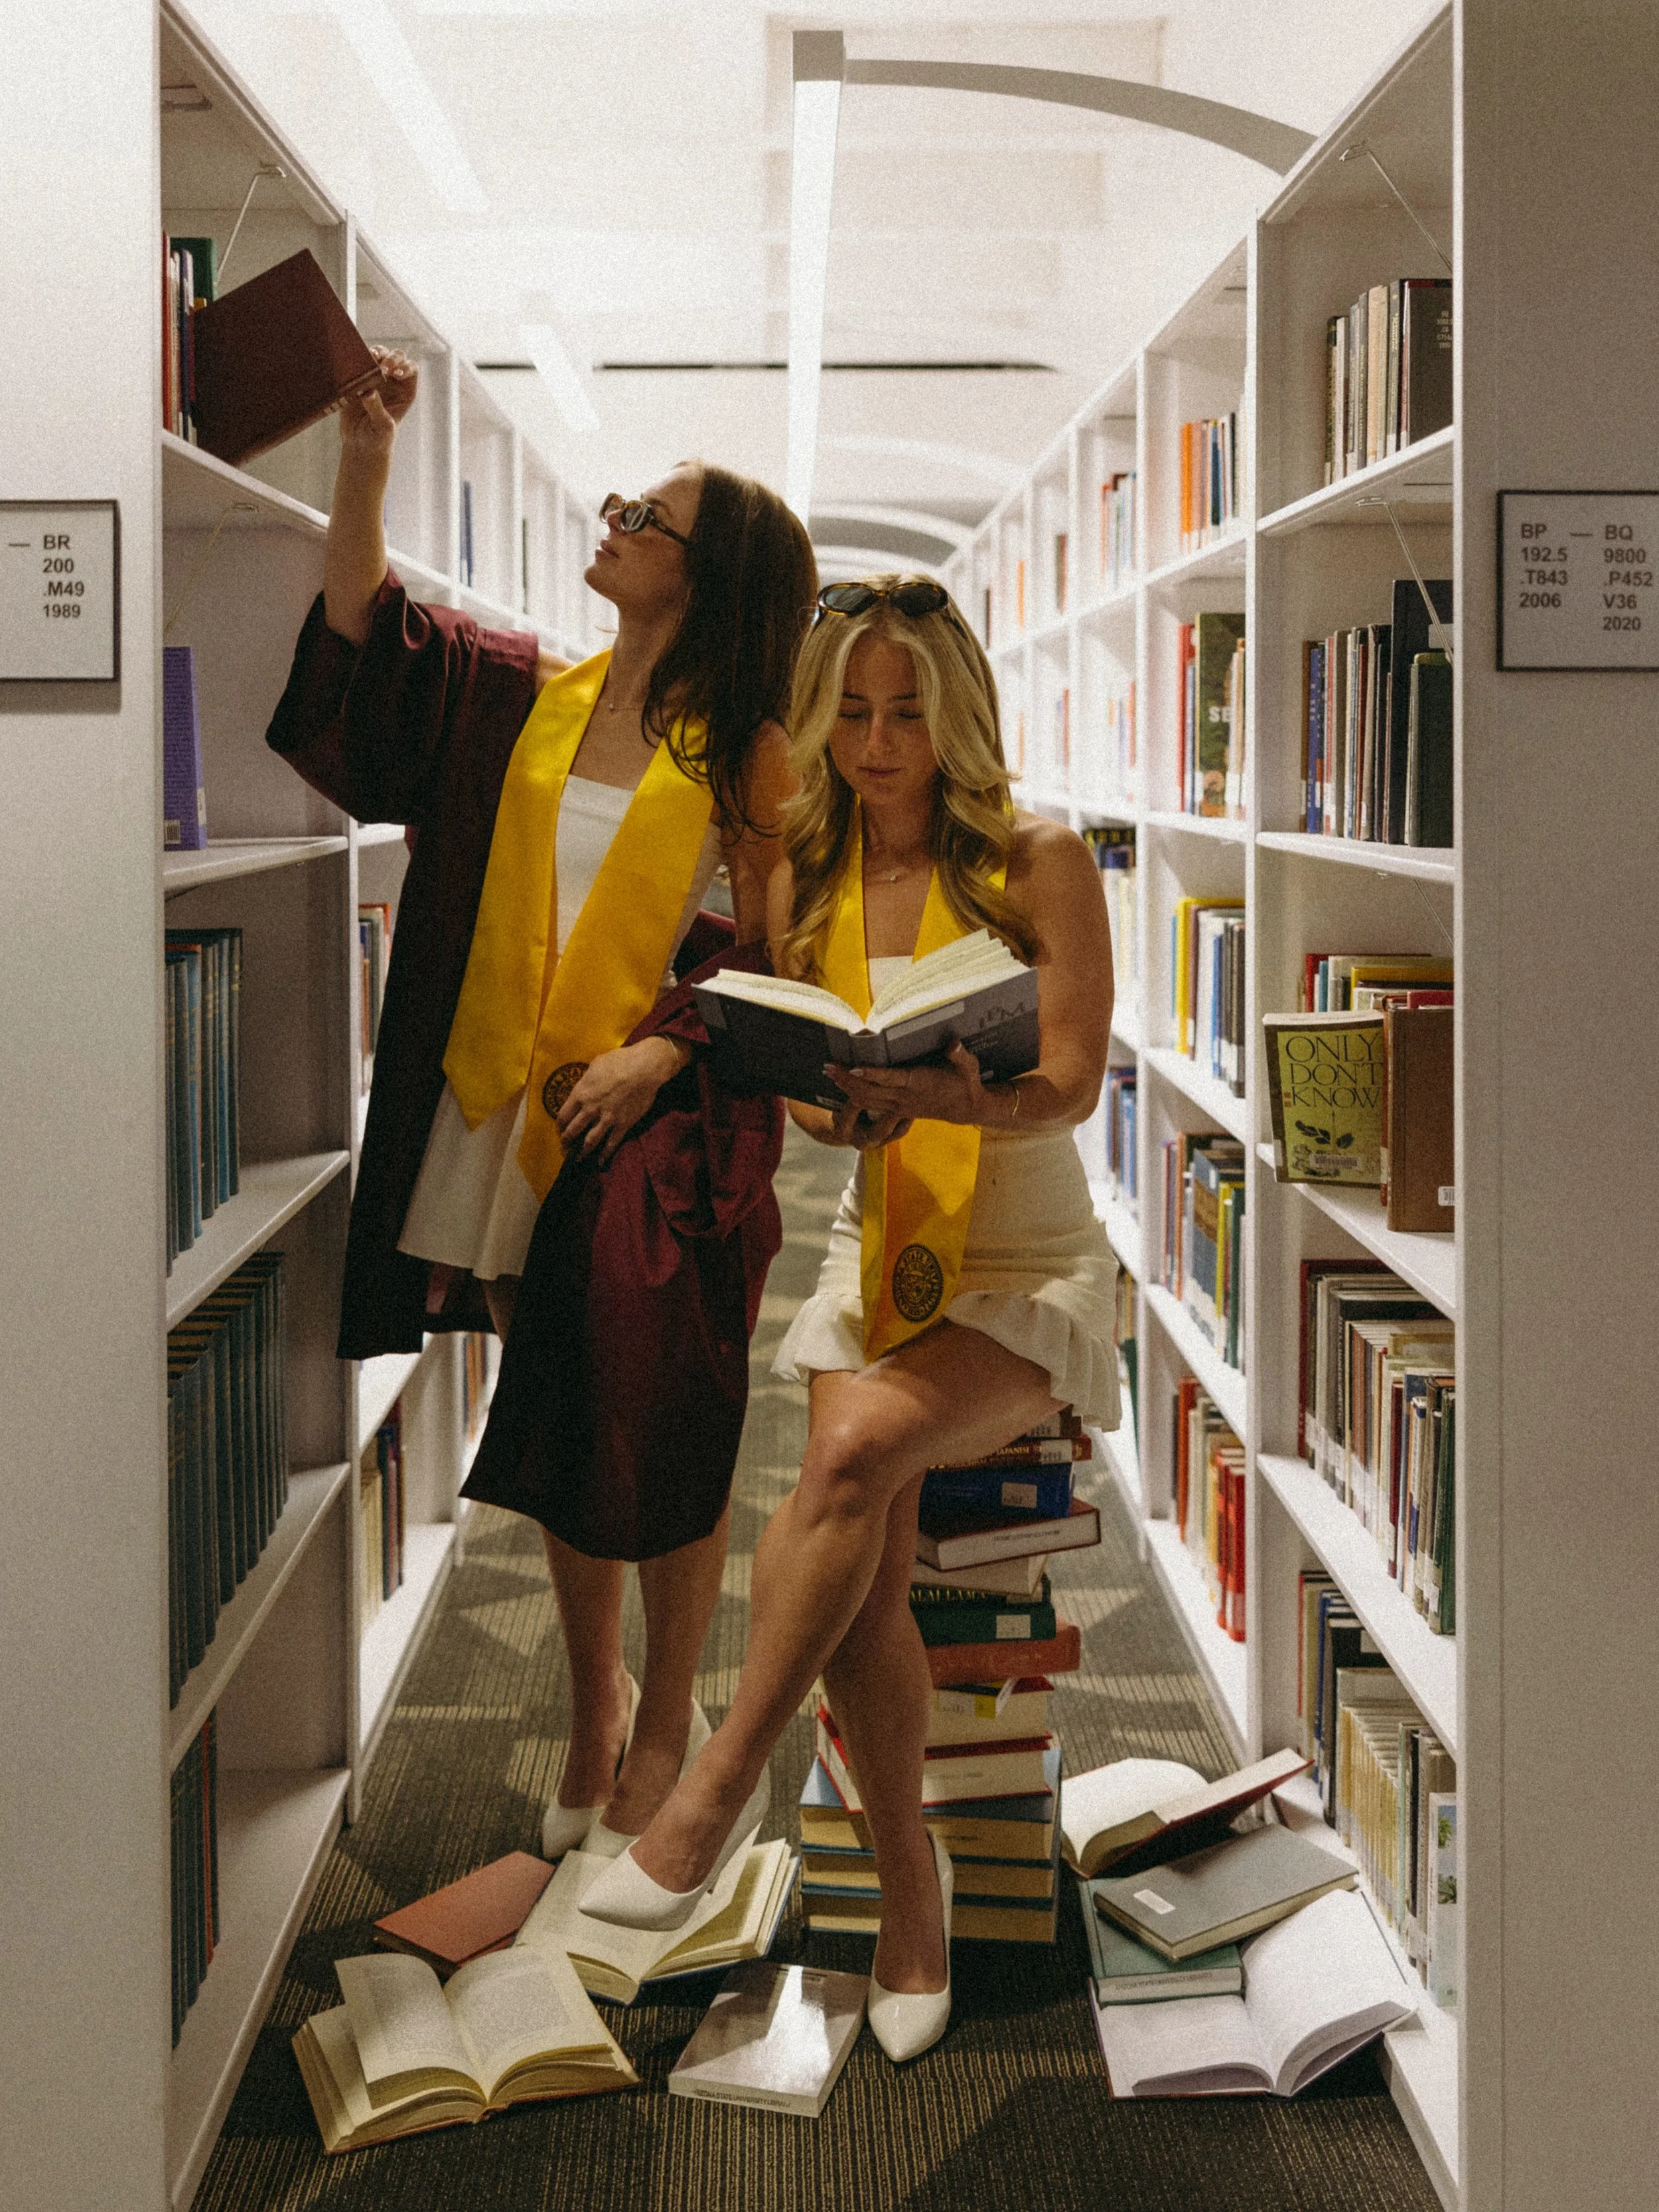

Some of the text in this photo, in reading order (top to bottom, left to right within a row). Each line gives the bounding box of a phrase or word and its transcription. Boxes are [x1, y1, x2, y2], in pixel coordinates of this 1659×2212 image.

[1520, 523, 1548, 539] BP
[1605, 524, 1634, 541] BQ
[42, 535, 71, 550] BR
[1521, 547, 1568, 563] 192.5
[1603, 548, 1646, 564] 9800
[42, 558, 74, 573] 200
[1520, 569, 1569, 586] .T843
[1603, 571, 1654, 587] .P452
[42, 581, 85, 597] .M49
[1519, 592, 1562, 609] 2006
[1603, 593, 1638, 610] V36
[42, 604, 81, 619] 1989
[1603, 616, 1642, 631] 2020
[1285, 1032, 1383, 1063] ONLY
[1290, 1062, 1384, 1086] DON'T
[1291, 1086, 1383, 1109] KNOW
